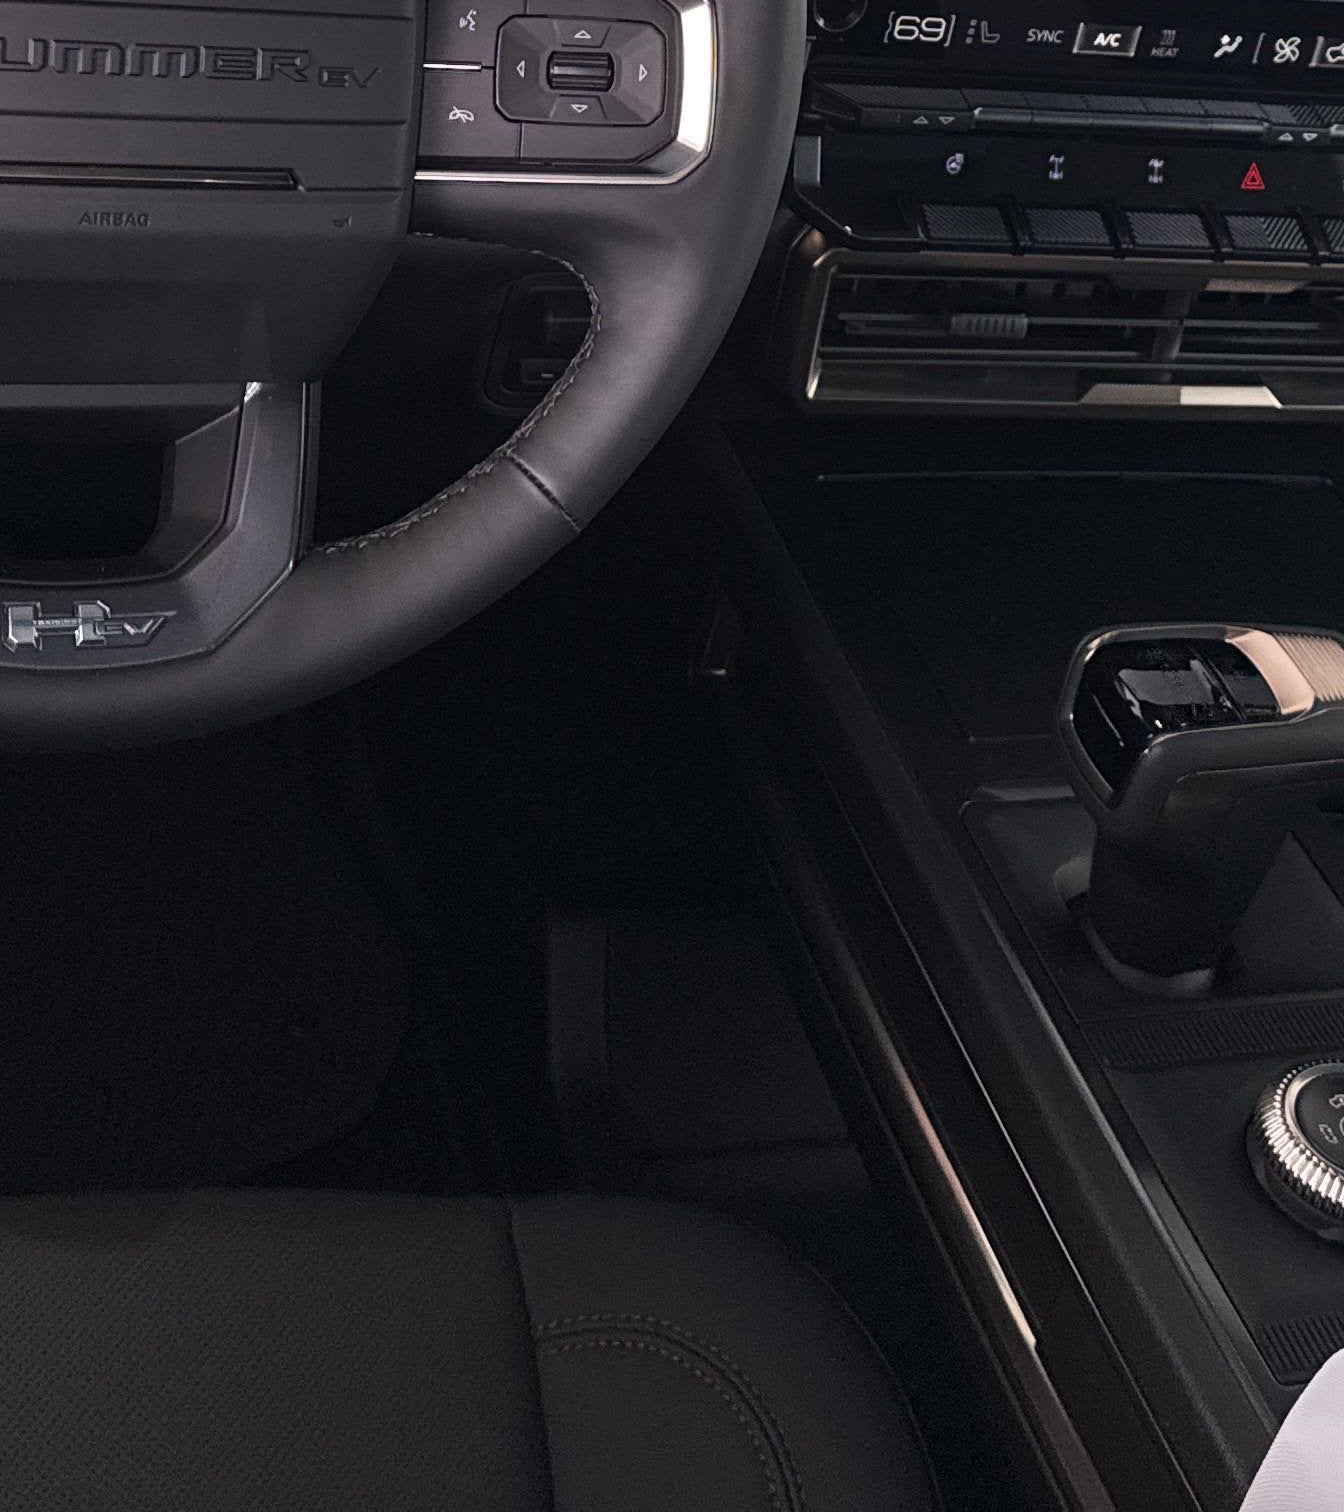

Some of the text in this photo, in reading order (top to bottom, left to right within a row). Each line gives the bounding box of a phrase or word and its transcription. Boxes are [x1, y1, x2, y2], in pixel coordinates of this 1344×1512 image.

[892, 14, 948, 43] 69
[1026, 28, 1064, 44] SYNC
[1093, 32, 1122, 48] A/C
[1150, 46, 1179, 58] HEAT
[317, 65, 383, 89] EV
[78, 210, 151, 228] AIRBAG
